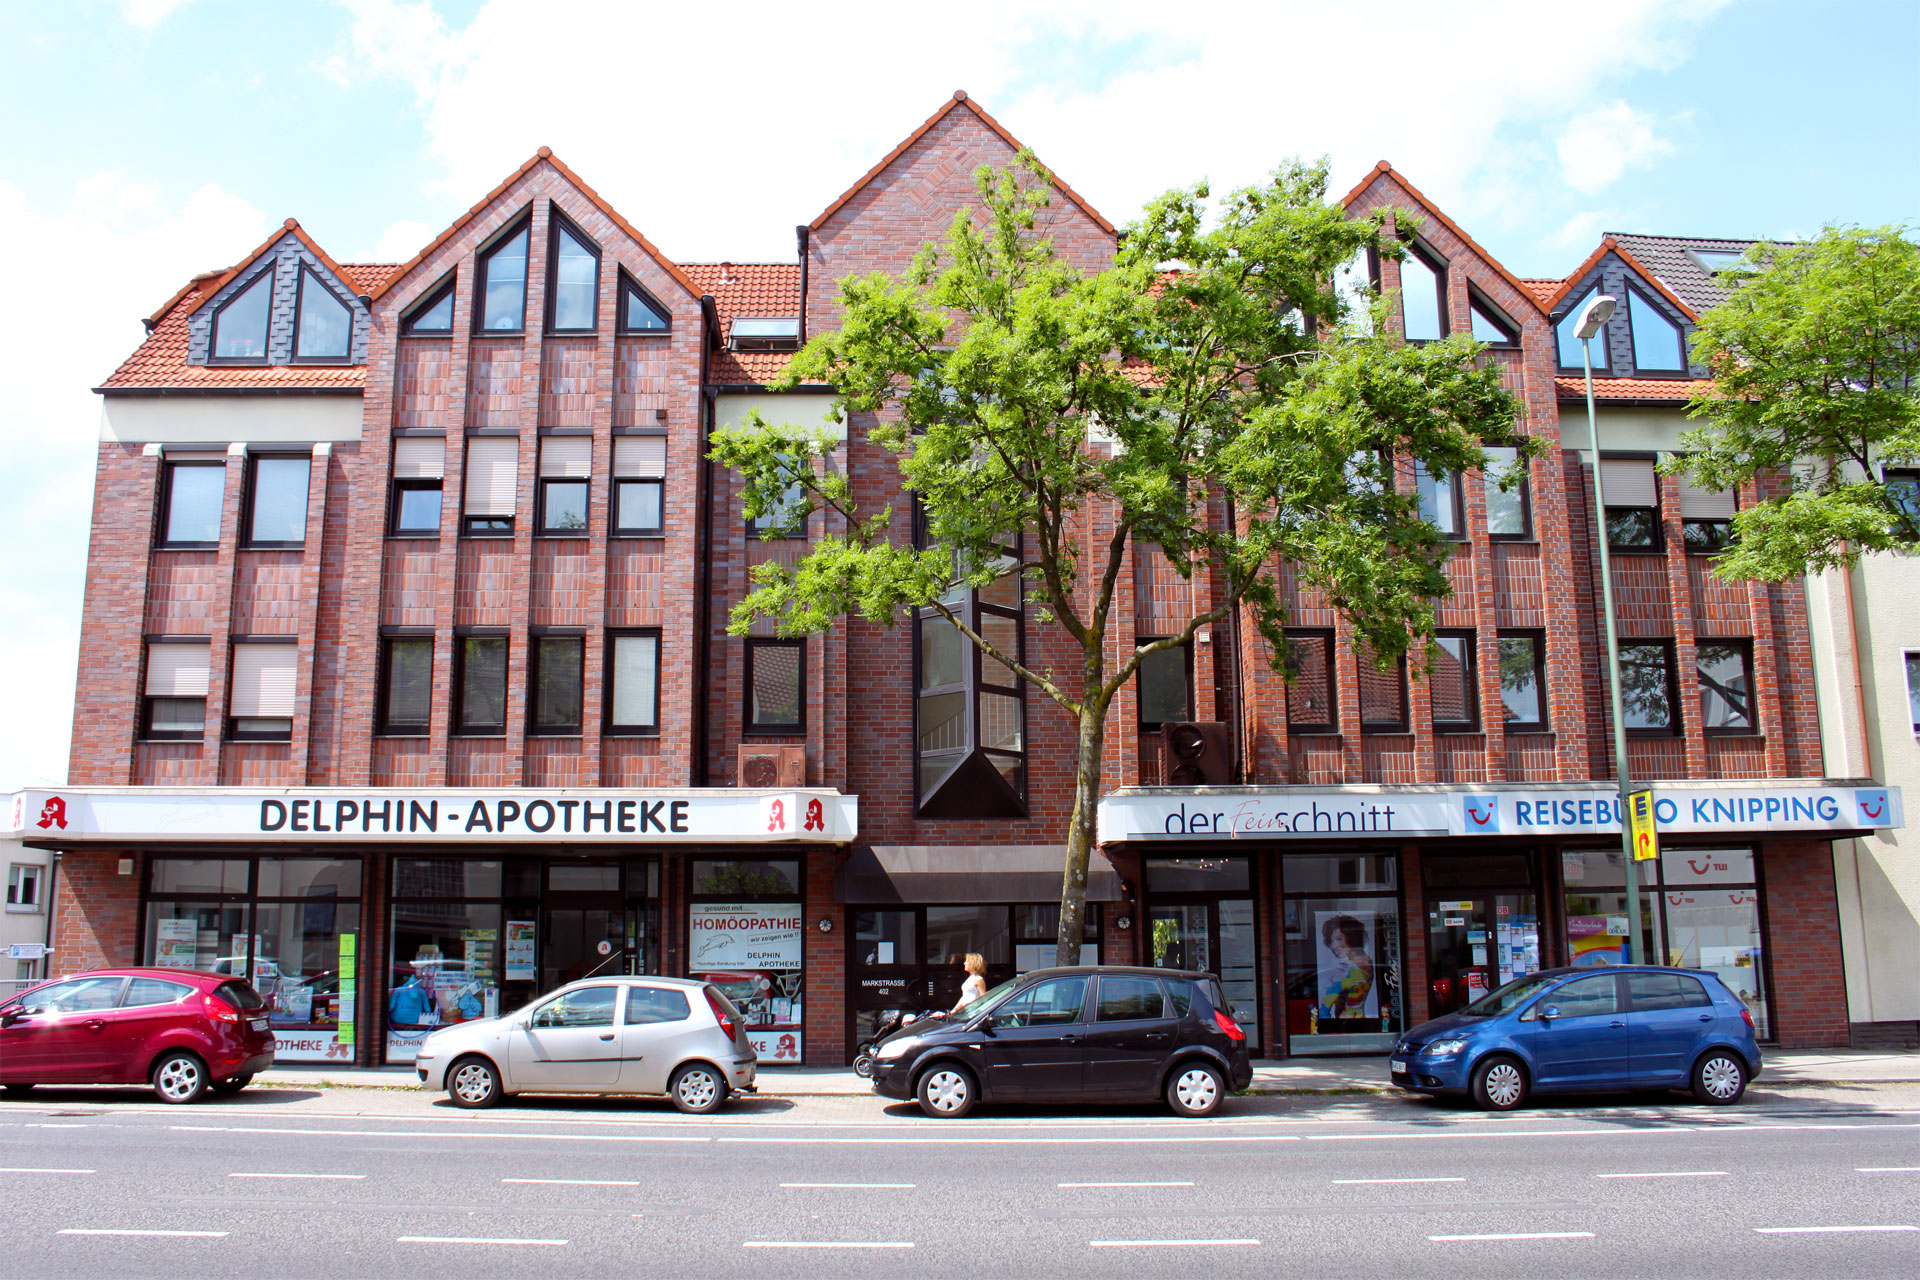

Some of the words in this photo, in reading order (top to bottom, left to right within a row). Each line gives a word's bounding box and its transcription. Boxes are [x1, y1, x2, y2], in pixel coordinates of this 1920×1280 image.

[1692, 796, 1839, 823] KNIPPING
[1165, 803, 1224, 834] der
[1713, 863, 1728, 871] TUI
[693, 916, 800, 930] HOMÖOPATHIE
[761, 934, 782, 942] zeigen
[758, 960, 801, 968] APOTHEKE
[389, 1039, 423, 1047] DELPHIN
